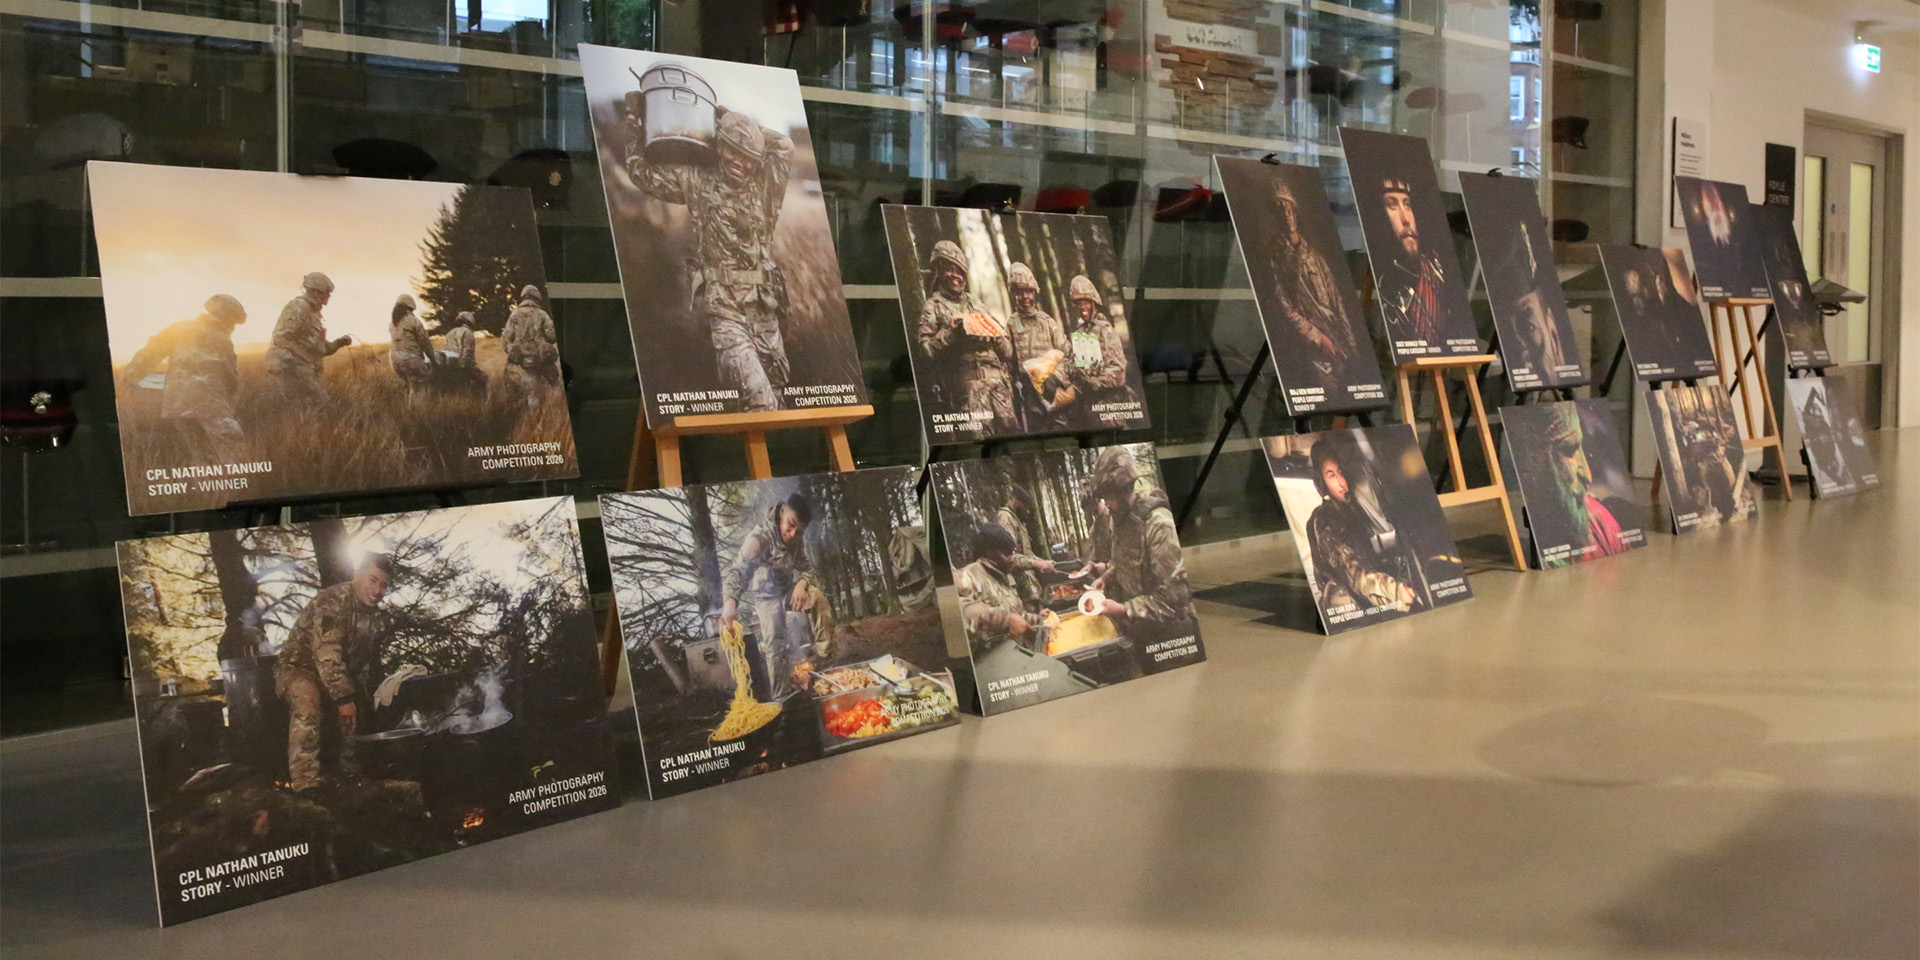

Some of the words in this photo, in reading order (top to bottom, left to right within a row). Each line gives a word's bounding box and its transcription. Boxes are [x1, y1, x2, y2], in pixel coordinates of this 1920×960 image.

[656, 393, 673, 403] CPL
[673, 391, 707, 401] NATHAN
[707, 389, 739, 400] TANUKU
[784, 386, 804, 396] ARMY
[805, 384, 855, 395] PHOTOGRAPHY
[659, 404, 685, 414] STORY
[690, 402, 724, 413] WINNER
[795, 395, 842, 406] COMPETITION
[842, 395, 858, 404] 2026
[1091, 404, 1106, 412] ARMY
[1106, 401, 1141, 411] PHOTOGRAPHY
[932, 414, 944, 423] CPL
[944, 412, 970, 422] NATHAN
[970, 410, 994, 420] TANUKU
[1099, 411, 1133, 421] COMPETITION
[934, 424, 954, 433] STORY
[958, 421, 983, 431] WINNER
[468, 446, 494, 457] ARMY
[496, 442, 561, 455] PHOTOGRAPHY
[146, 469, 170, 481] CPL
[172, 464, 223, 479] NATHAN
[224, 461, 273, 475] TANUKU
[482, 455, 544, 470] COMPETITION
[545, 454, 564, 465] 2026
[148, 482, 188, 496] STORY
[198, 477, 248, 492] WINNER
[1146, 643, 1160, 654] ARMY
[1160, 635, 1196, 650] PHOTOGRAPHY
[1154, 647, 1188, 662] COMPETITION
[988, 682, 1000, 691] CPL
[1000, 675, 1025, 689] NATHAN
[1025, 669, 1049, 682] TANUKU
[990, 690, 1010, 702] STORY
[1014, 682, 1040, 696] WINNER
[881, 704, 900, 716] ARMY
[901, 694, 948, 713] PHOTOGRAPHY
[891, 708, 936, 727] COMPETITION
[660, 758, 676, 769] CPL
[677, 748, 712, 765] NATHAN
[712, 741, 746, 757] TANUKU
[662, 767, 689, 782] STORY
[695, 757, 730, 774] WINNER
[509, 787, 536, 804] ARMY
[538, 771, 605, 796] PHOTOGRAPHY
[523, 791, 586, 815] COMPETITION
[587, 784, 607, 799] 2026
[179, 869, 203, 885] CPL
[205, 855, 258, 879] NATHAN
[260, 843, 309, 865] TANUKU
[181, 880, 222, 902] STORY
[232, 865, 284, 889] WINNER
